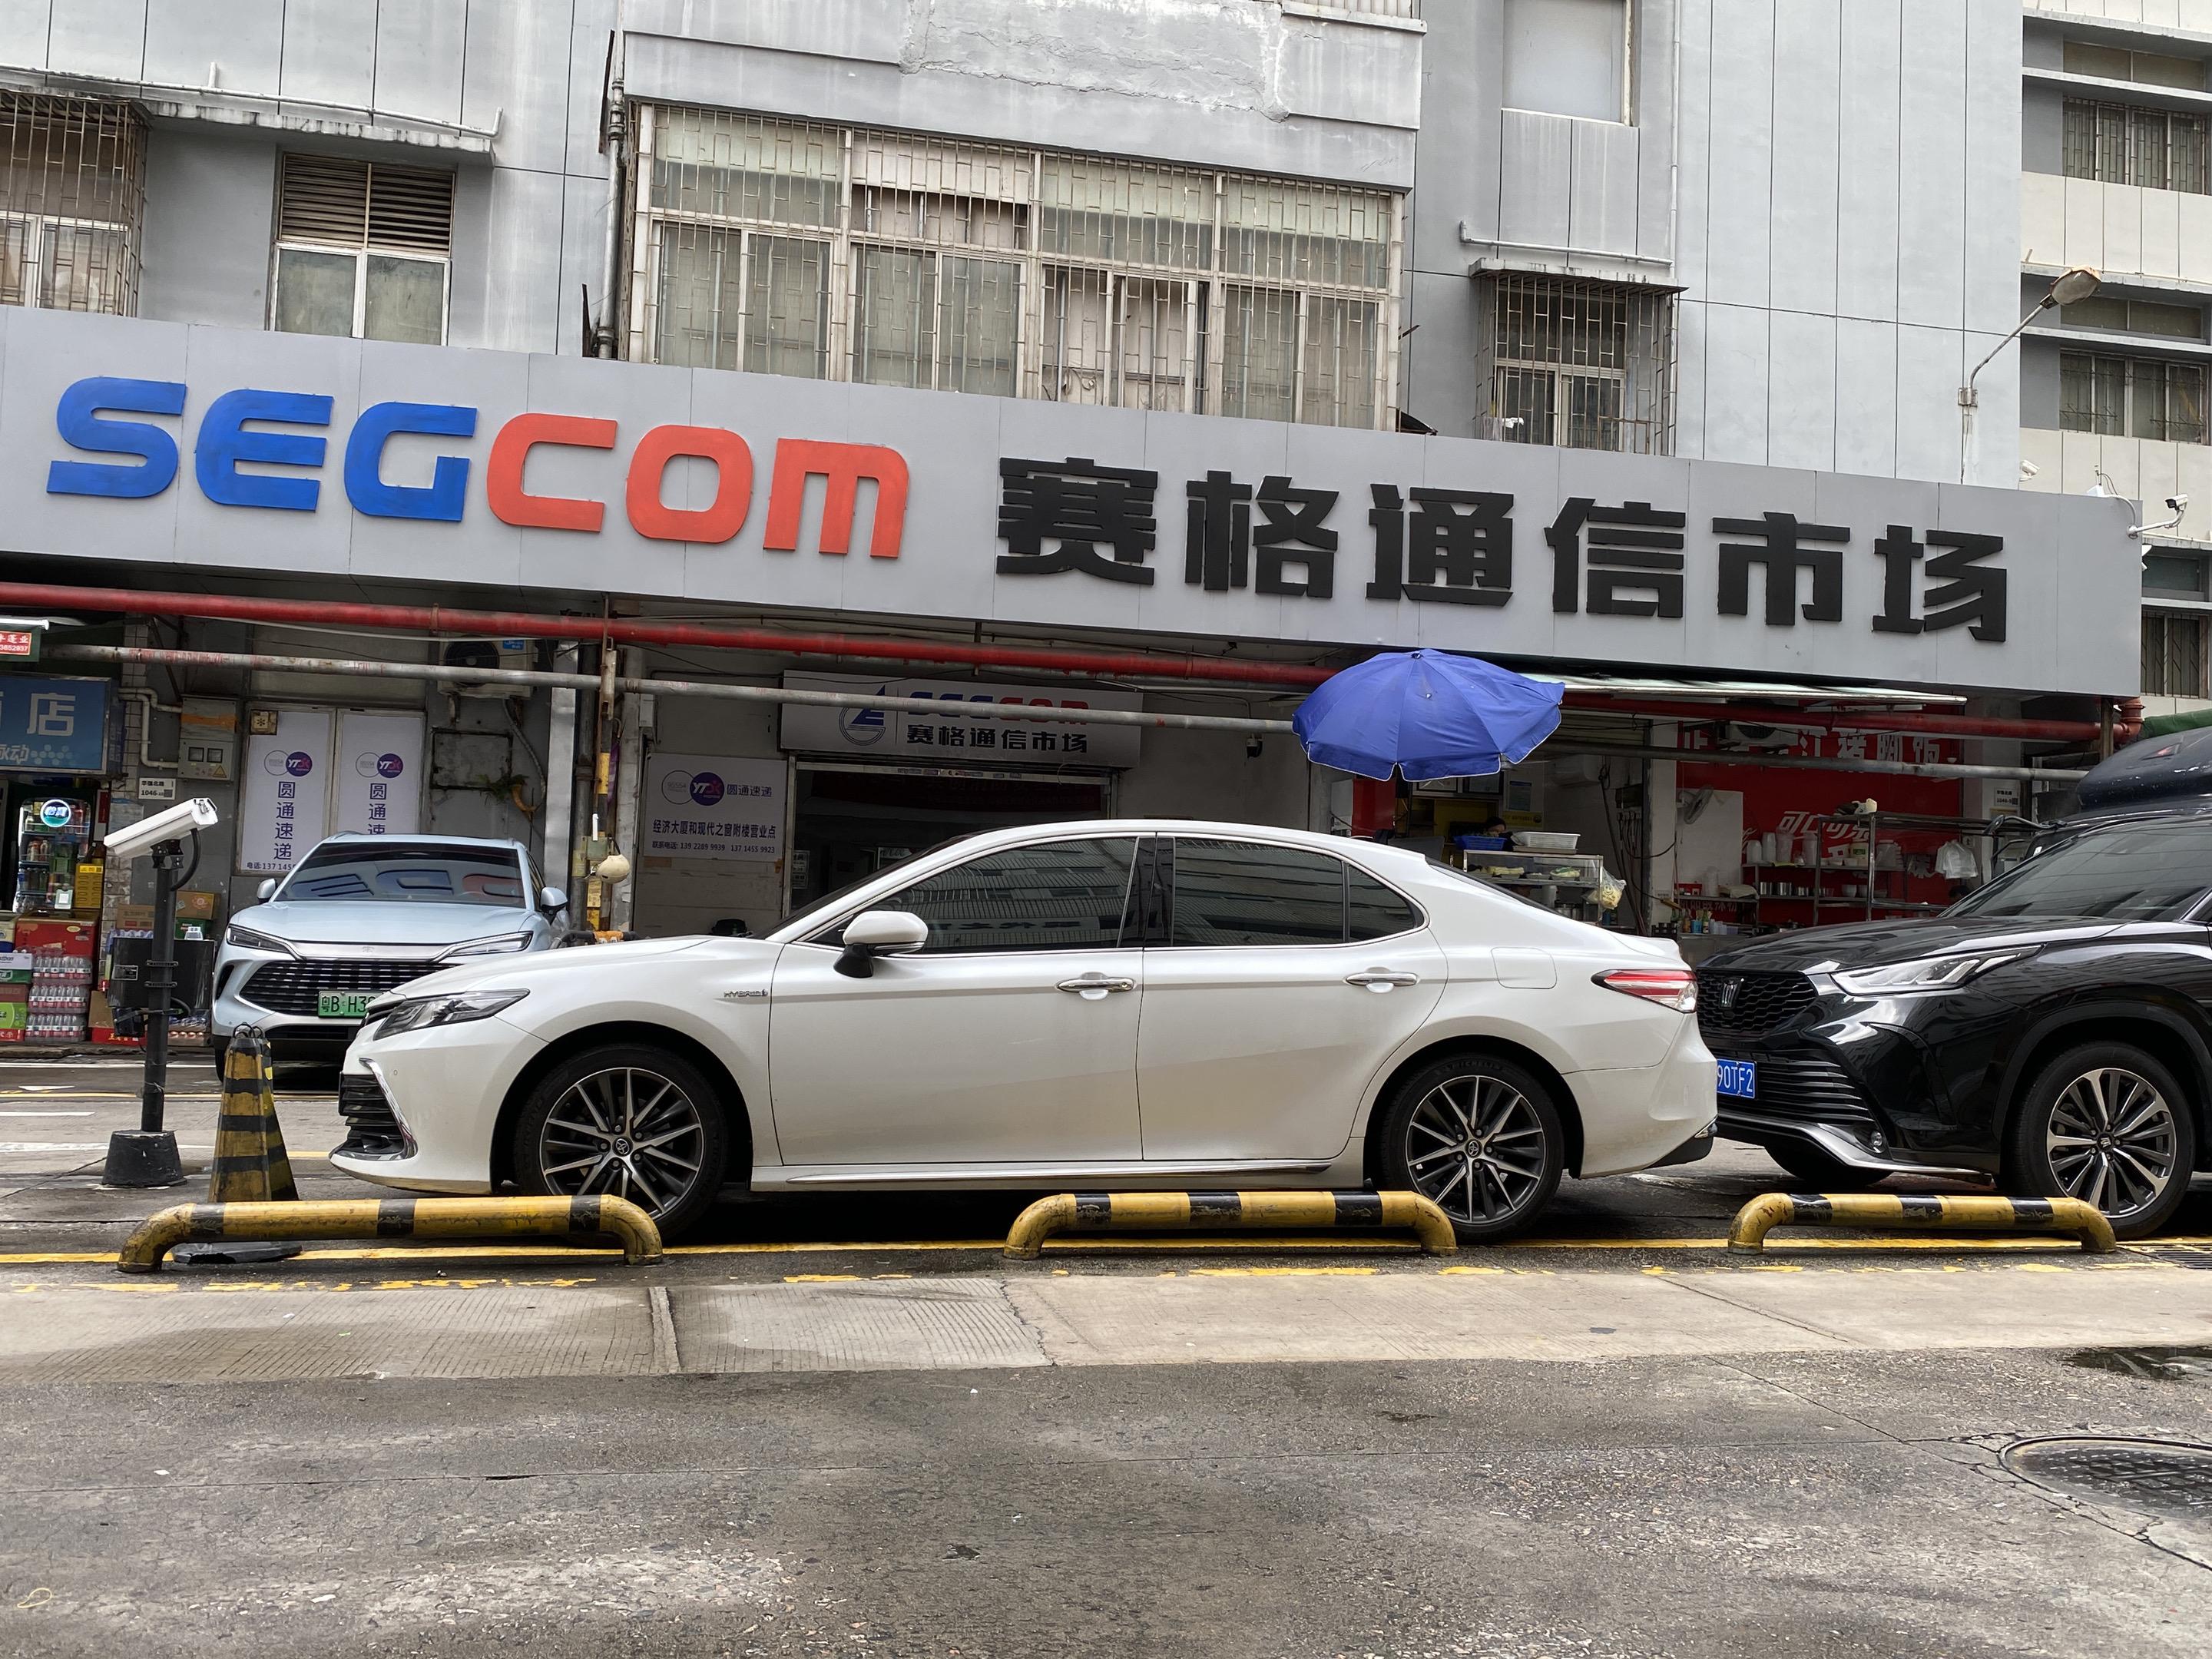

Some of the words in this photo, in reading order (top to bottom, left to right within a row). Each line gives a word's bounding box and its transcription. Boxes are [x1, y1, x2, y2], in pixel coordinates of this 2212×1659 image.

[47, 376, 911, 559] SEGCOM
[996, 456, 2007, 643] 赛格通信市场
[0, 693, 76, 736] 店
[906, 724, 1088, 753] 赛格通信市场
[727, 783, 773, 798] 圆通速递
[273, 781, 296, 860] 圆通速递
[653, 819, 776, 839] 经济大厦和现代之窗附楼营业点
[1717, 1065, 1753, 1093] 90TF2
